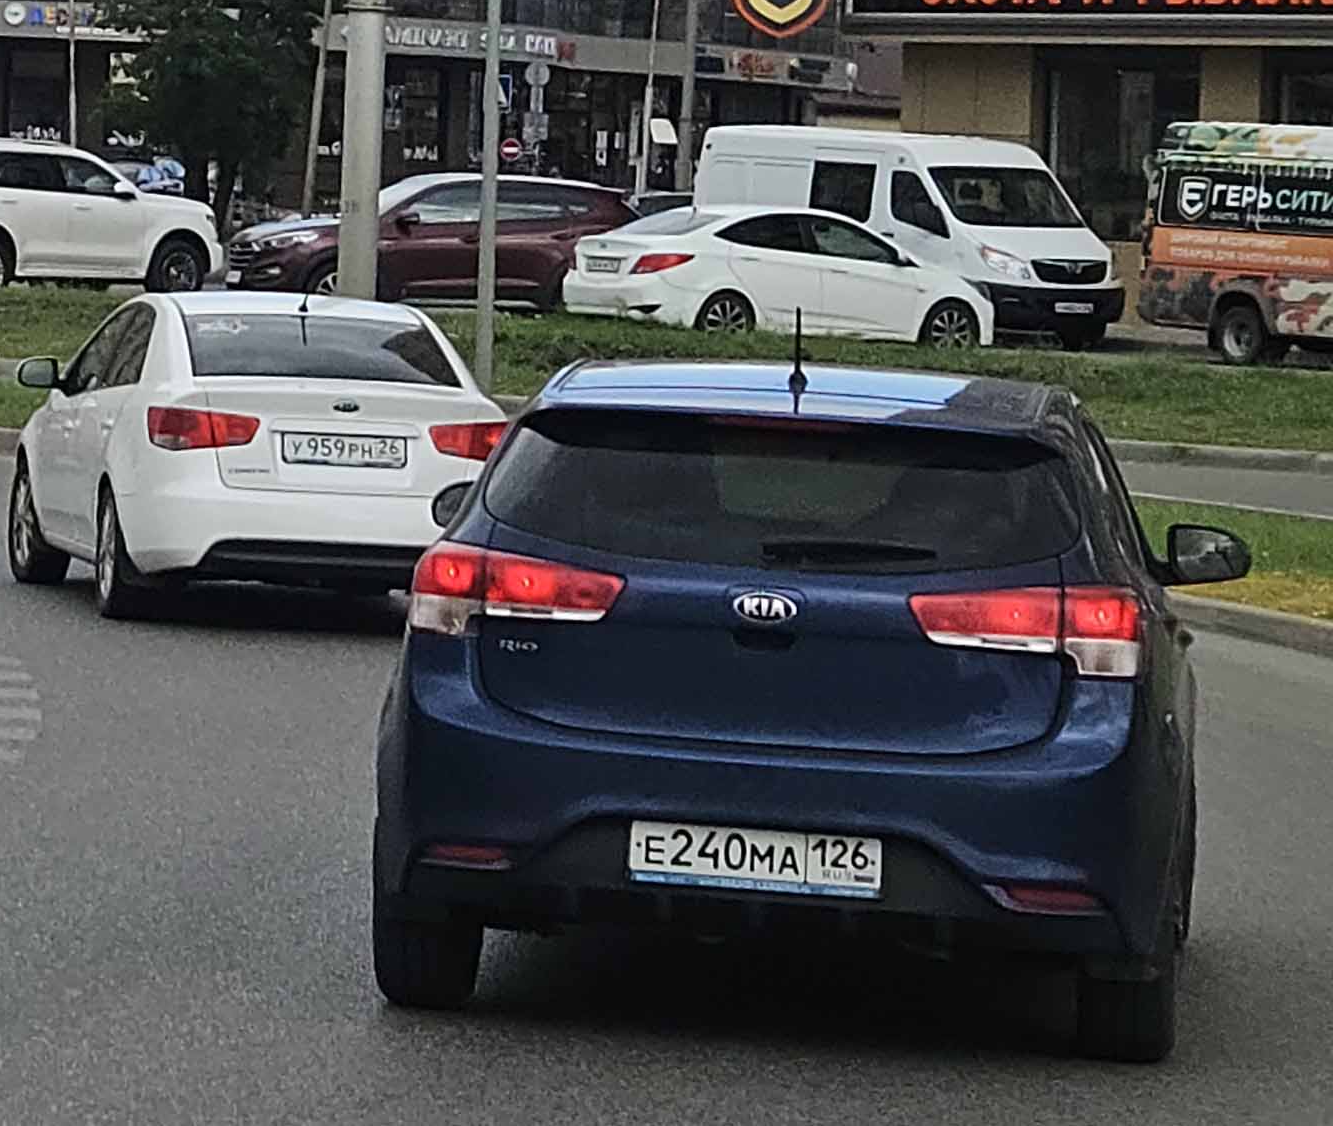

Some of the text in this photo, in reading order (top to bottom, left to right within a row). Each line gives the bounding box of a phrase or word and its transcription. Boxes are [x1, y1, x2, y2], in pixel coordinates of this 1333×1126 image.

[291, 437, 400, 459] У959РН 26
[743, 597, 786, 618] KIA
[644, 827, 870, 876] Е240МА 126
